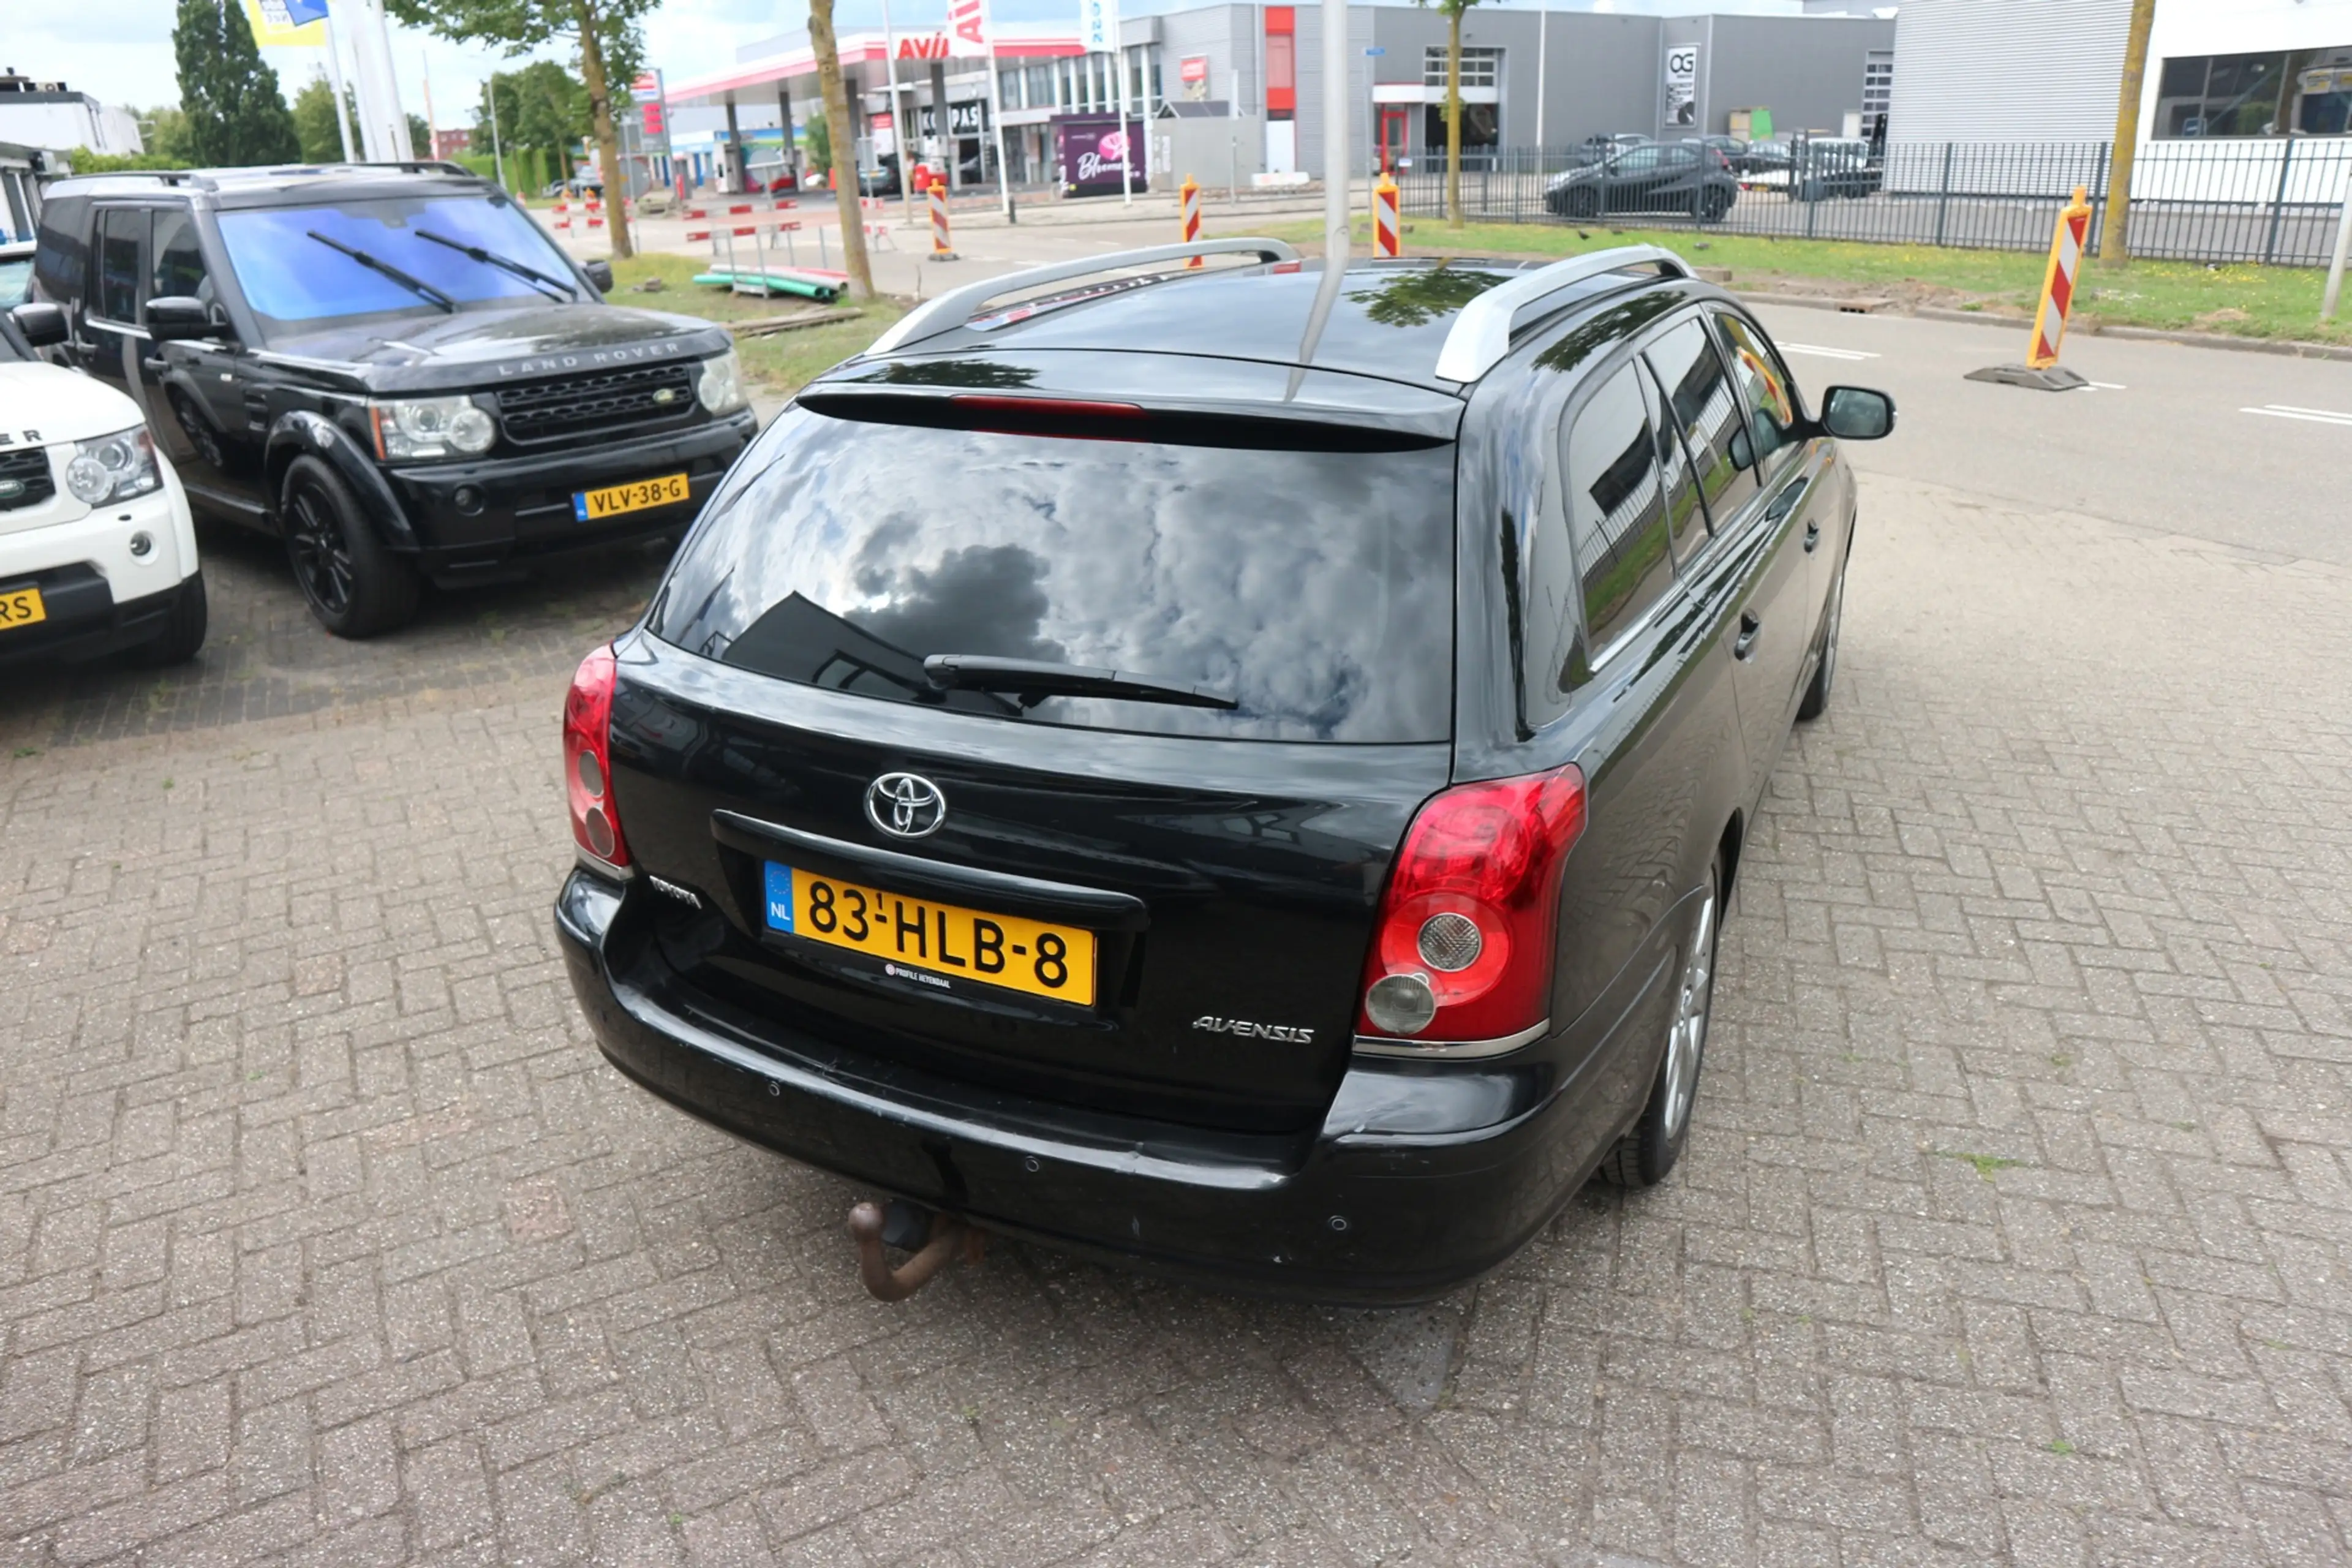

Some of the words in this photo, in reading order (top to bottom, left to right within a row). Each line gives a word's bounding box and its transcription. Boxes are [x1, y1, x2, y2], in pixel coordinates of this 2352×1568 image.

[497, 356, 578, 377] LAND
[594, 342, 679, 364] ROVER
[592, 478, 681, 513] VLV-38-G
[649, 875, 702, 910] TOYOTA
[771, 902, 791, 921] NL
[1193, 1016, 1314, 1044] AVENSIS
